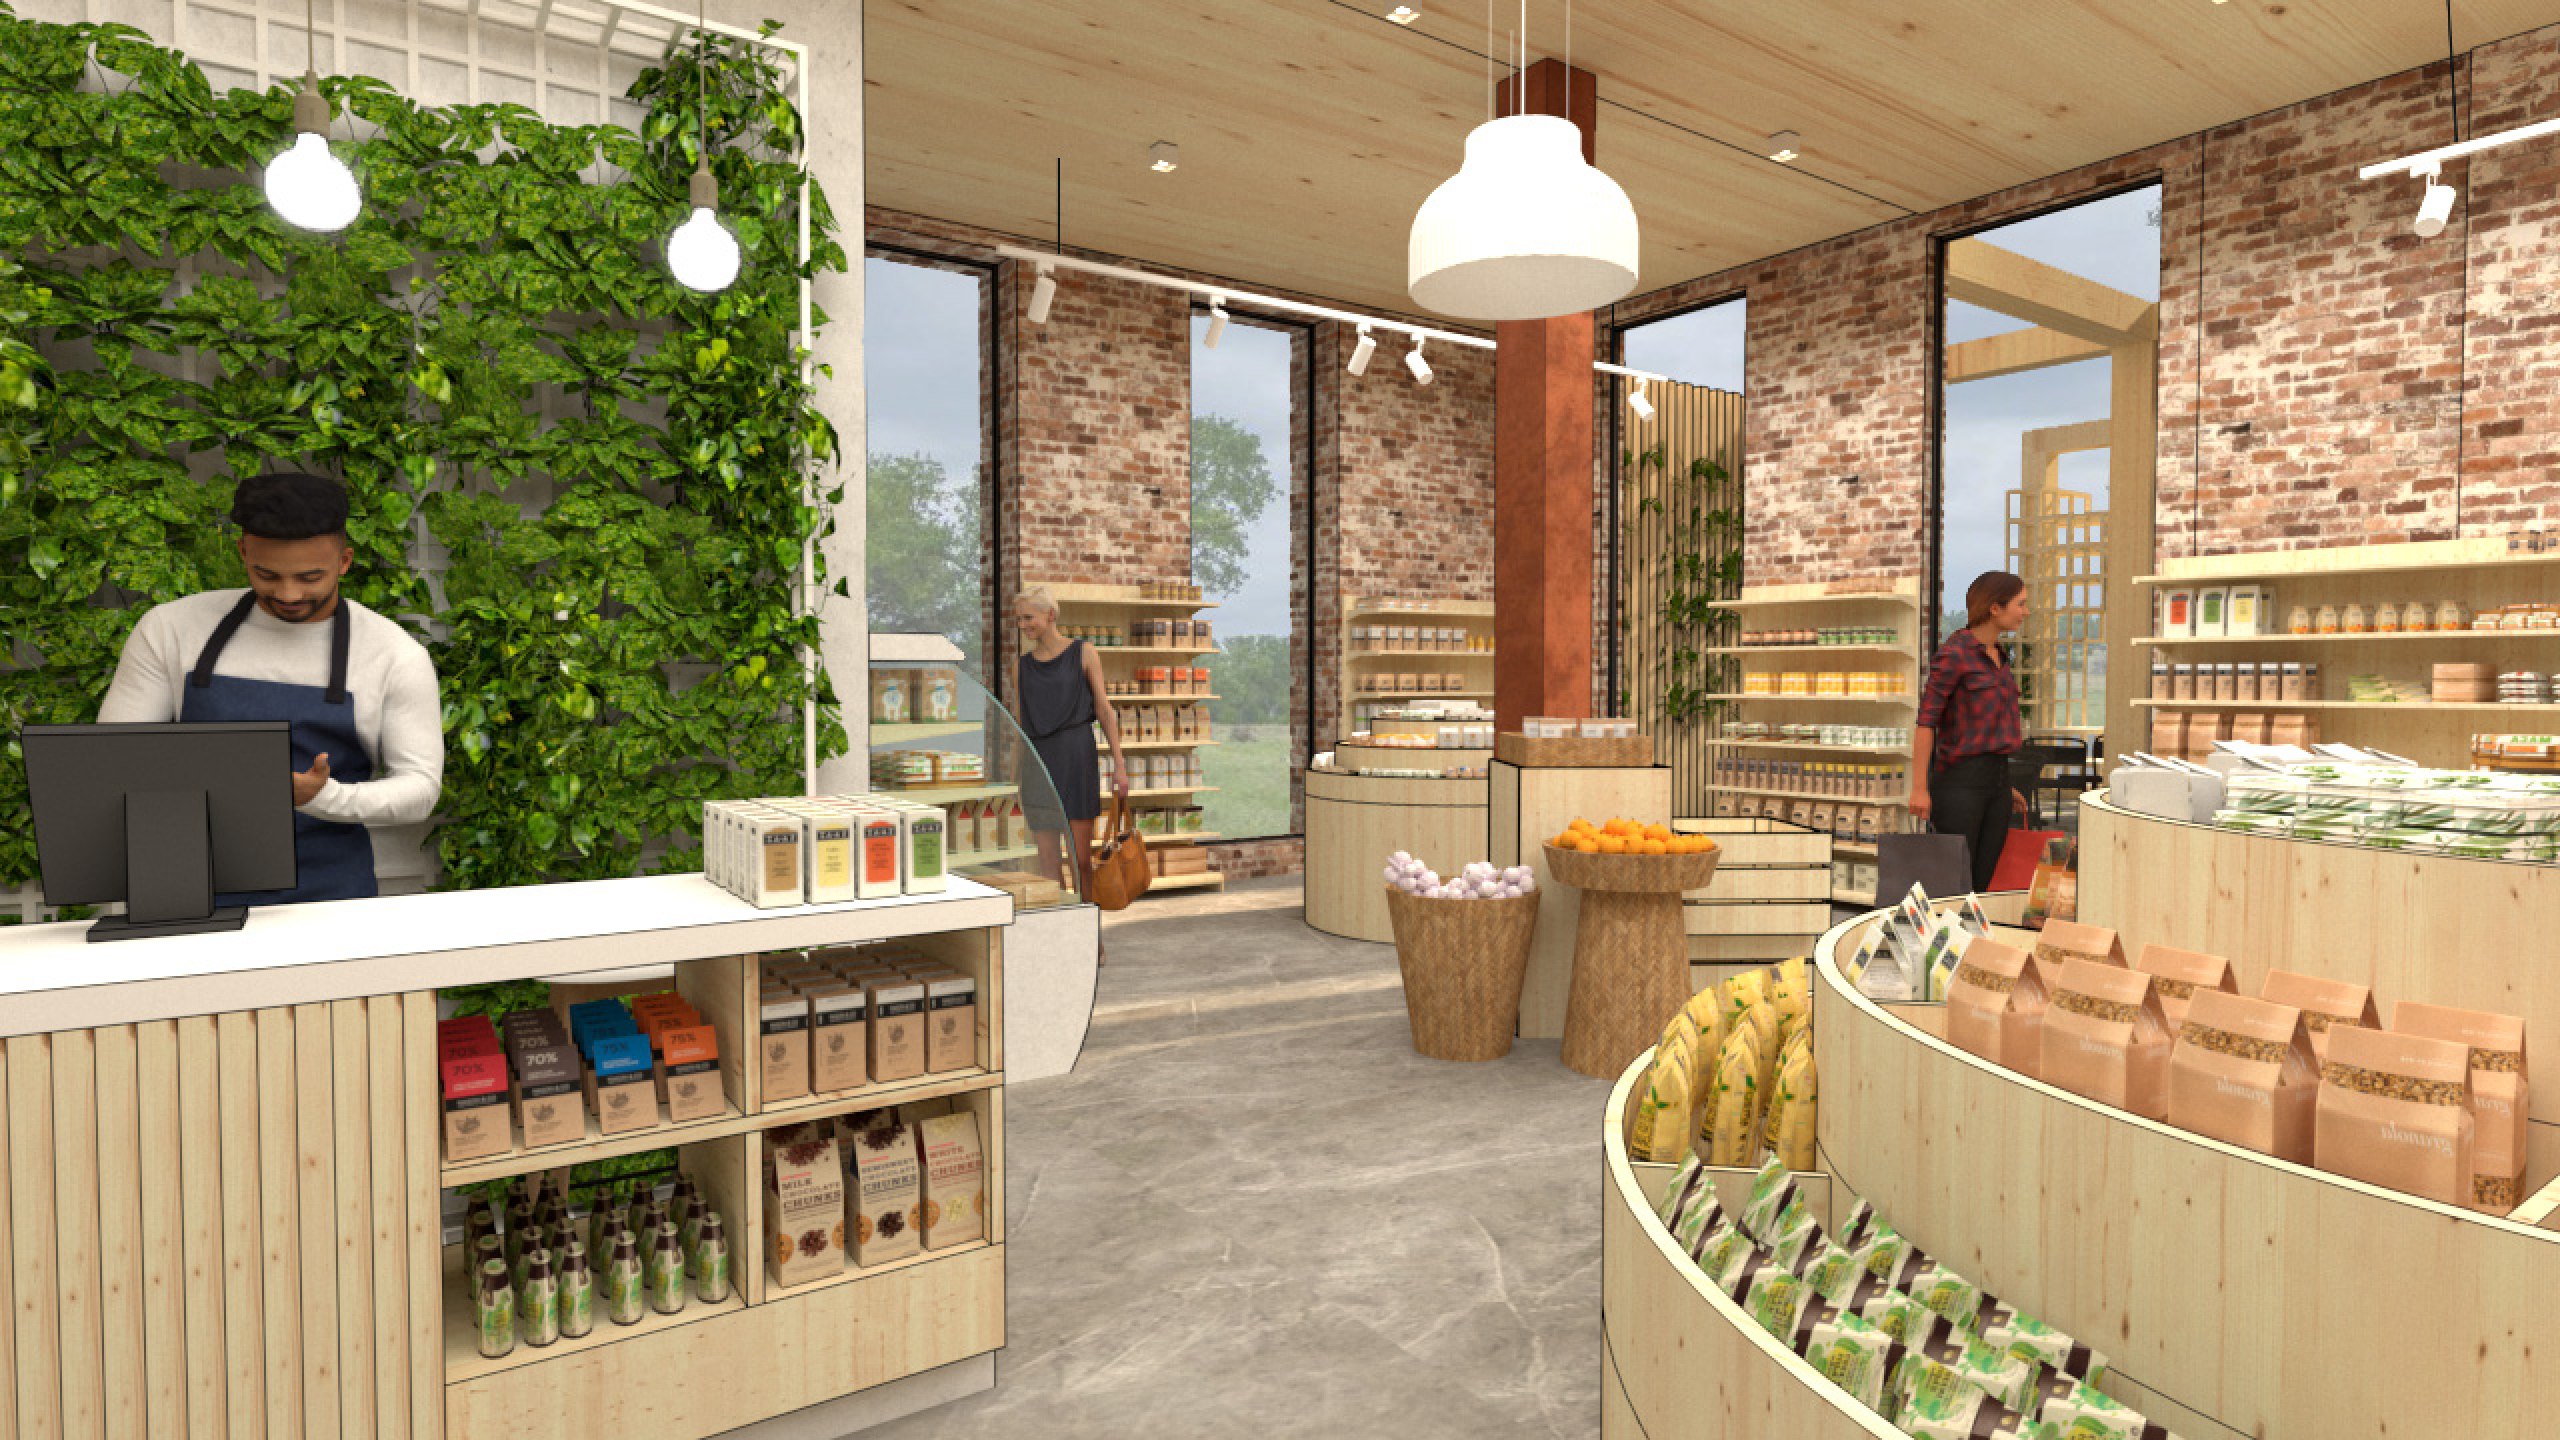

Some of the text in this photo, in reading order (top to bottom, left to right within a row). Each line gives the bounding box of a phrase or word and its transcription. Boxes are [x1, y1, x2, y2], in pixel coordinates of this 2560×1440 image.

[525, 1052, 559, 1066] 70%
[453, 1063, 485, 1077] 70%
[862, 1165, 917, 1182] CHOCOLATE
[781, 1177, 813, 1190] MILK
[782, 1181, 841, 1199] CHOCOLATE
[863, 1174, 918, 1192] CHUNKS
[783, 1189, 842, 1210] CHUNKS
